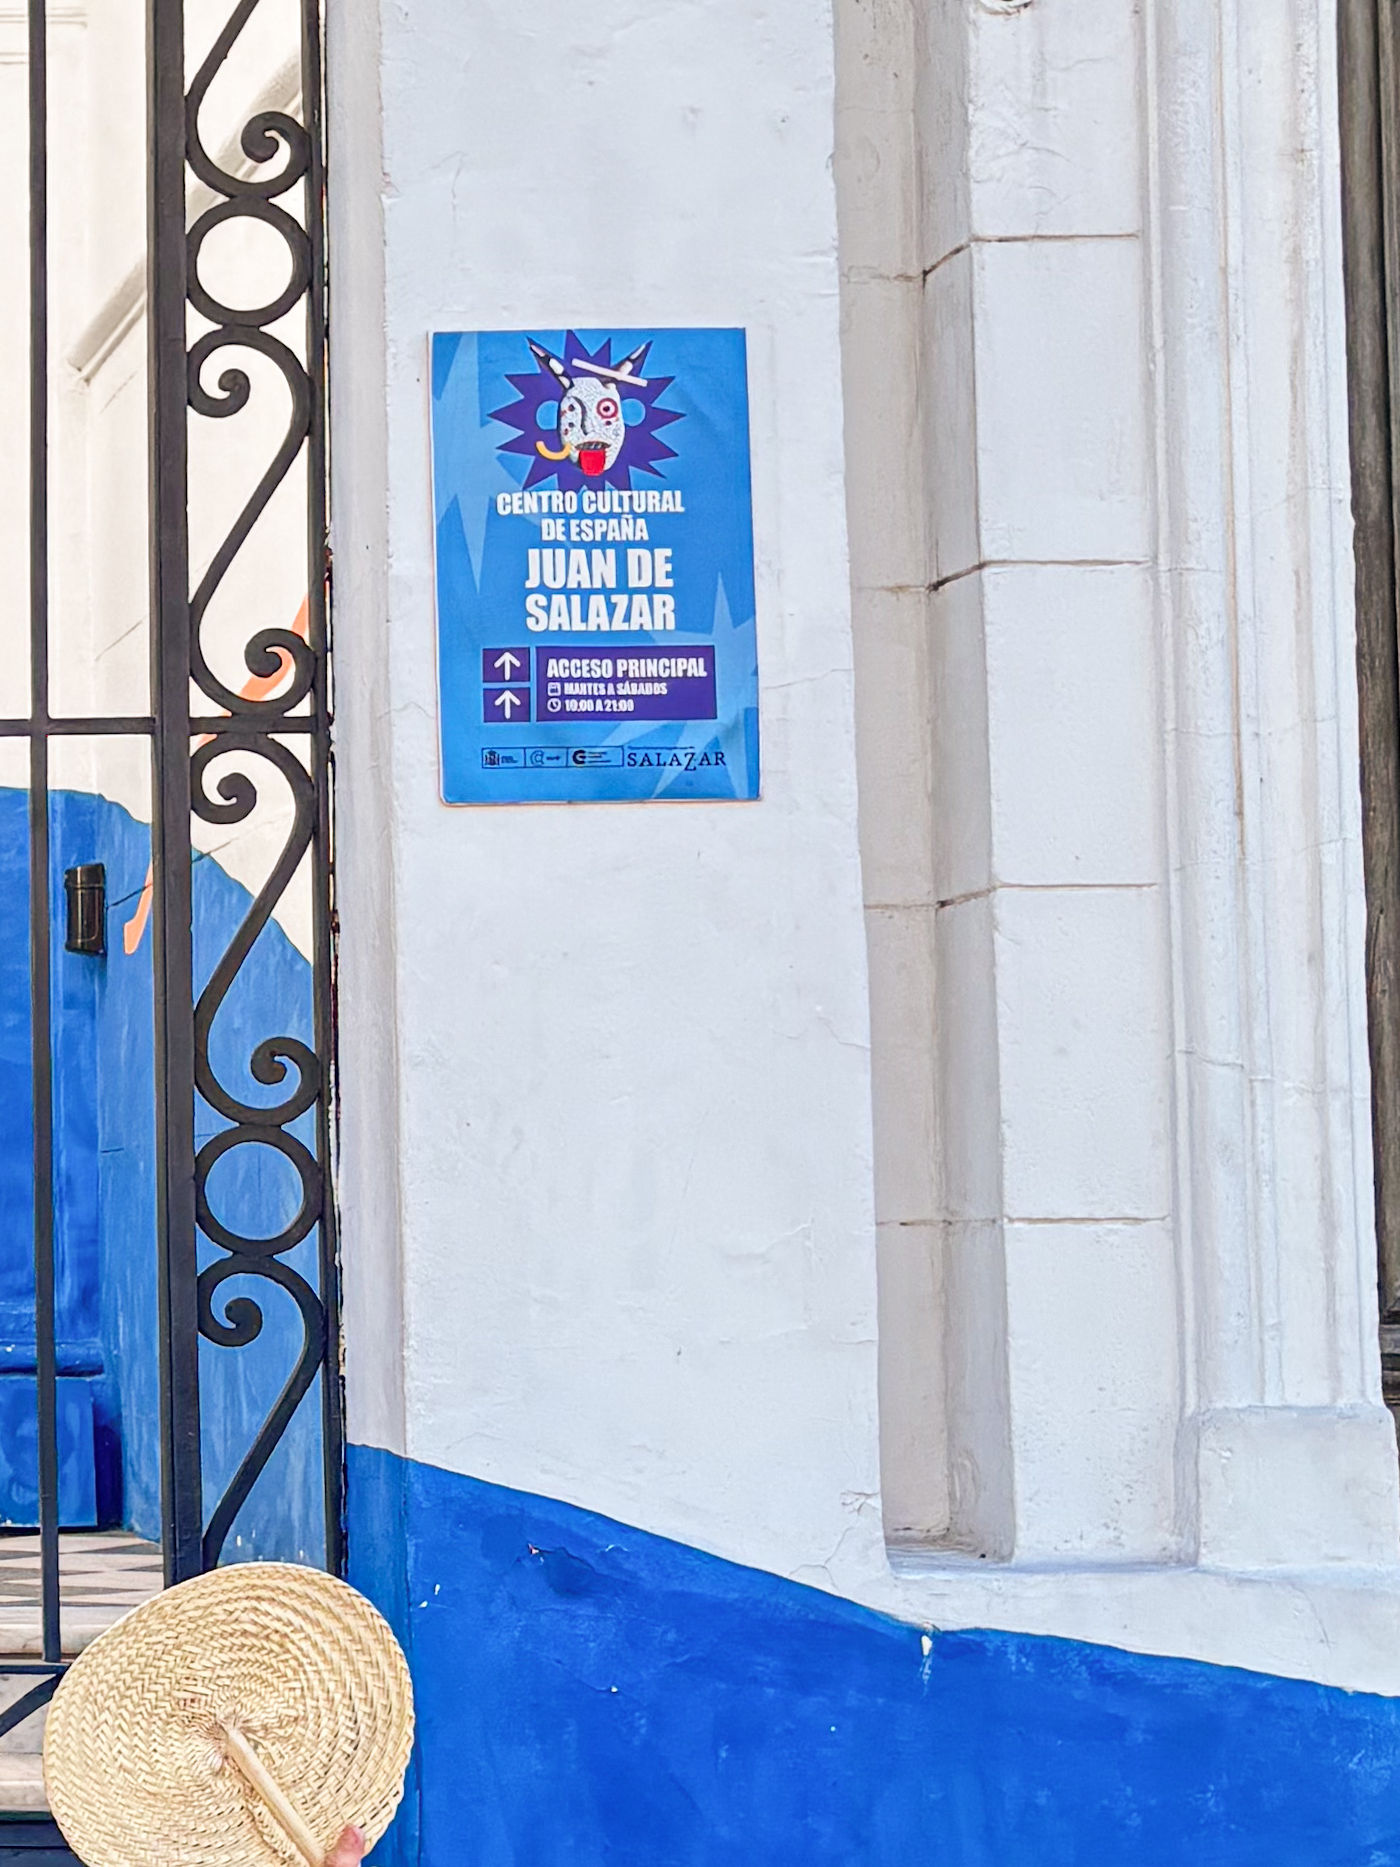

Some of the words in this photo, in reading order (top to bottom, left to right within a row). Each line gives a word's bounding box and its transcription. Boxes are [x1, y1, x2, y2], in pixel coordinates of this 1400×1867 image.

[496, 491, 578, 516] CENTRO
[582, 489, 686, 514] CULTURAL
[541, 518, 567, 542] DE
[569, 514, 649, 542] ESPAÑA
[525, 548, 617, 589] JUAN
[627, 548, 674, 589] DE
[525, 593, 676, 632] SALAZAR
[547, 657, 614, 679] ACCESO
[616, 657, 708, 678] PRINCIPAL
[564, 682, 606, 696] MARTES
[607, 682, 615, 696] A
[616, 680, 668, 695] SÁBADOS
[595, 699, 603, 712] A
[627, 751, 727, 772] SALAZAR
